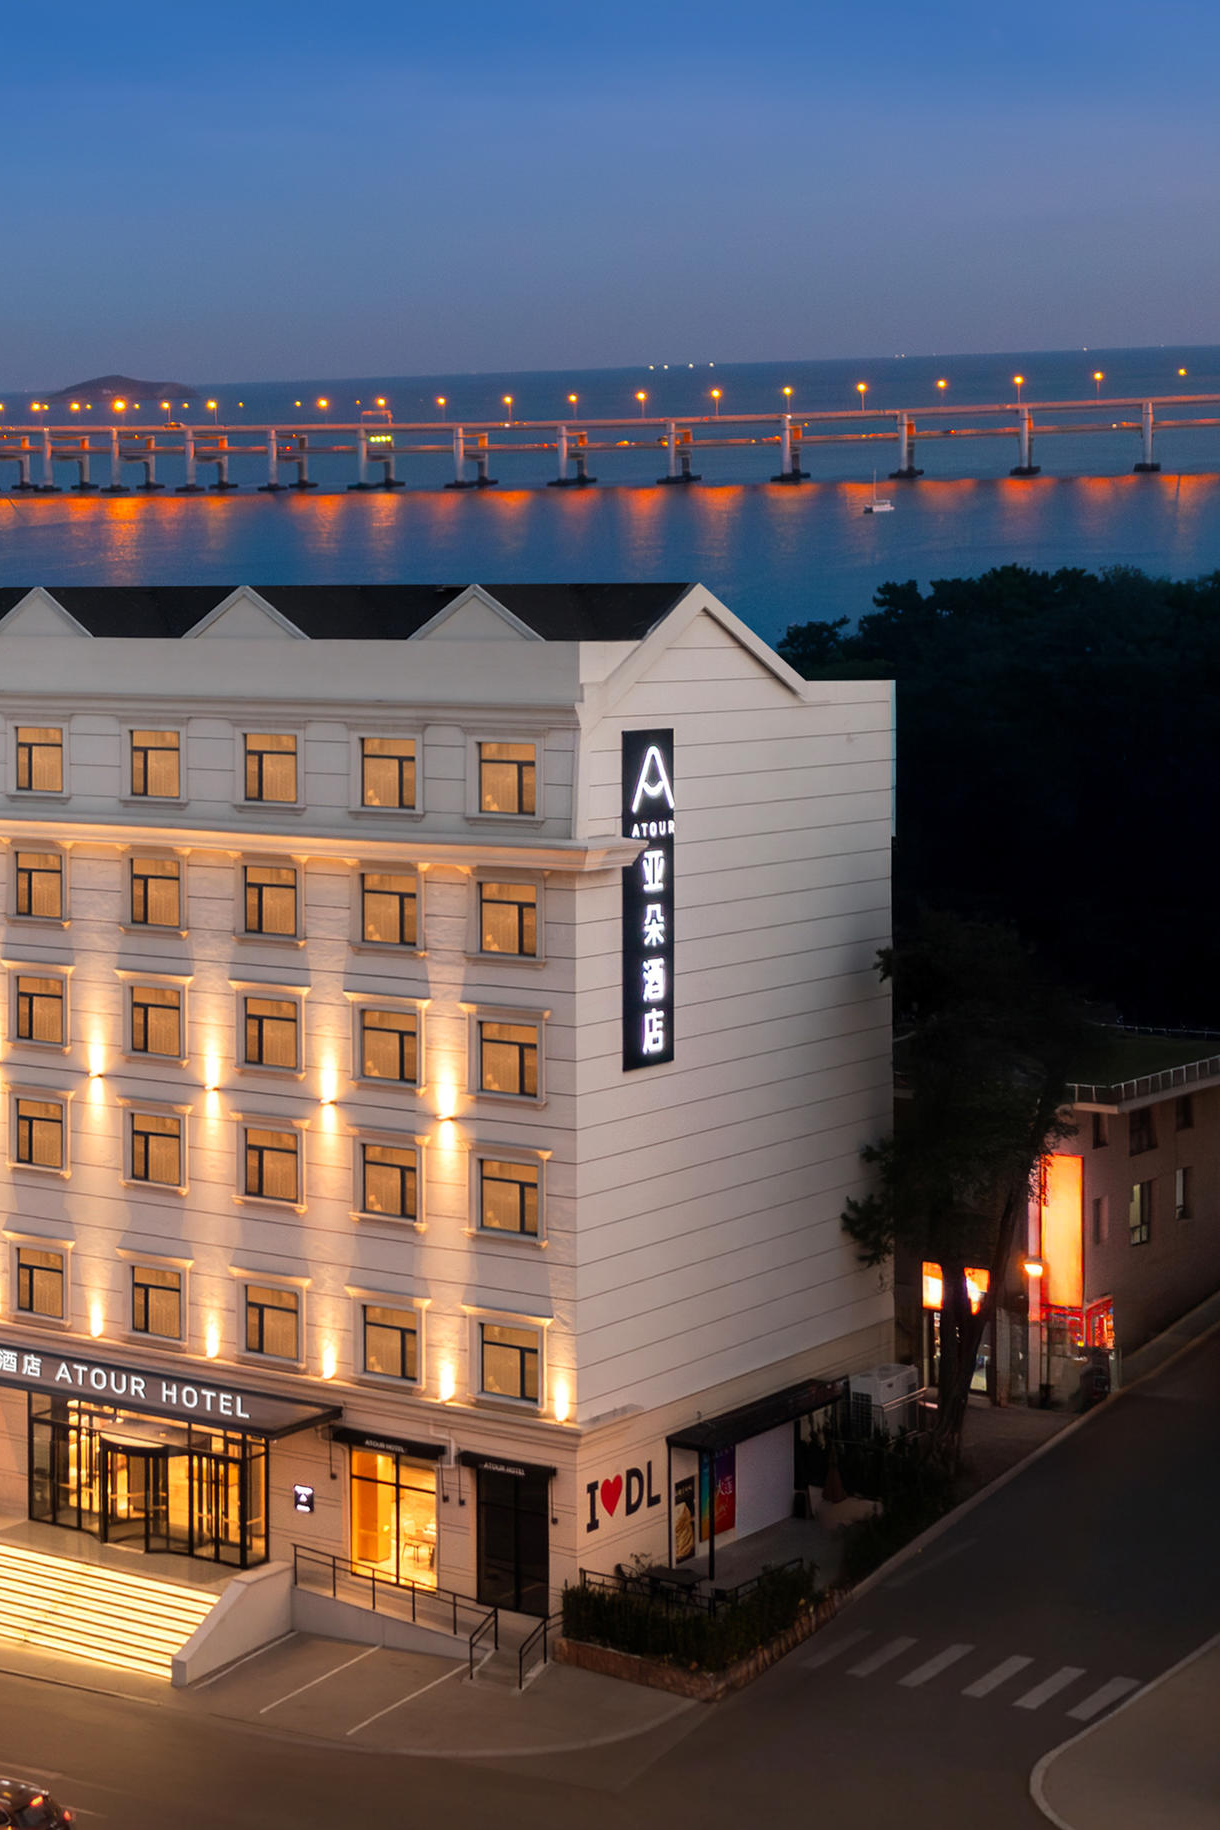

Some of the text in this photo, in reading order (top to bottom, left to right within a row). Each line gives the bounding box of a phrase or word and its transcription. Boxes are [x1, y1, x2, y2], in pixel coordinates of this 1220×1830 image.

[631, 819, 676, 838] ATOUR
[642, 850, 665, 1055] 亚朵酒店
[55, 1362, 146, 1399] ATOUR
[161, 1382, 251, 1418] HOTEL
[586, 1460, 661, 1533] I DL
